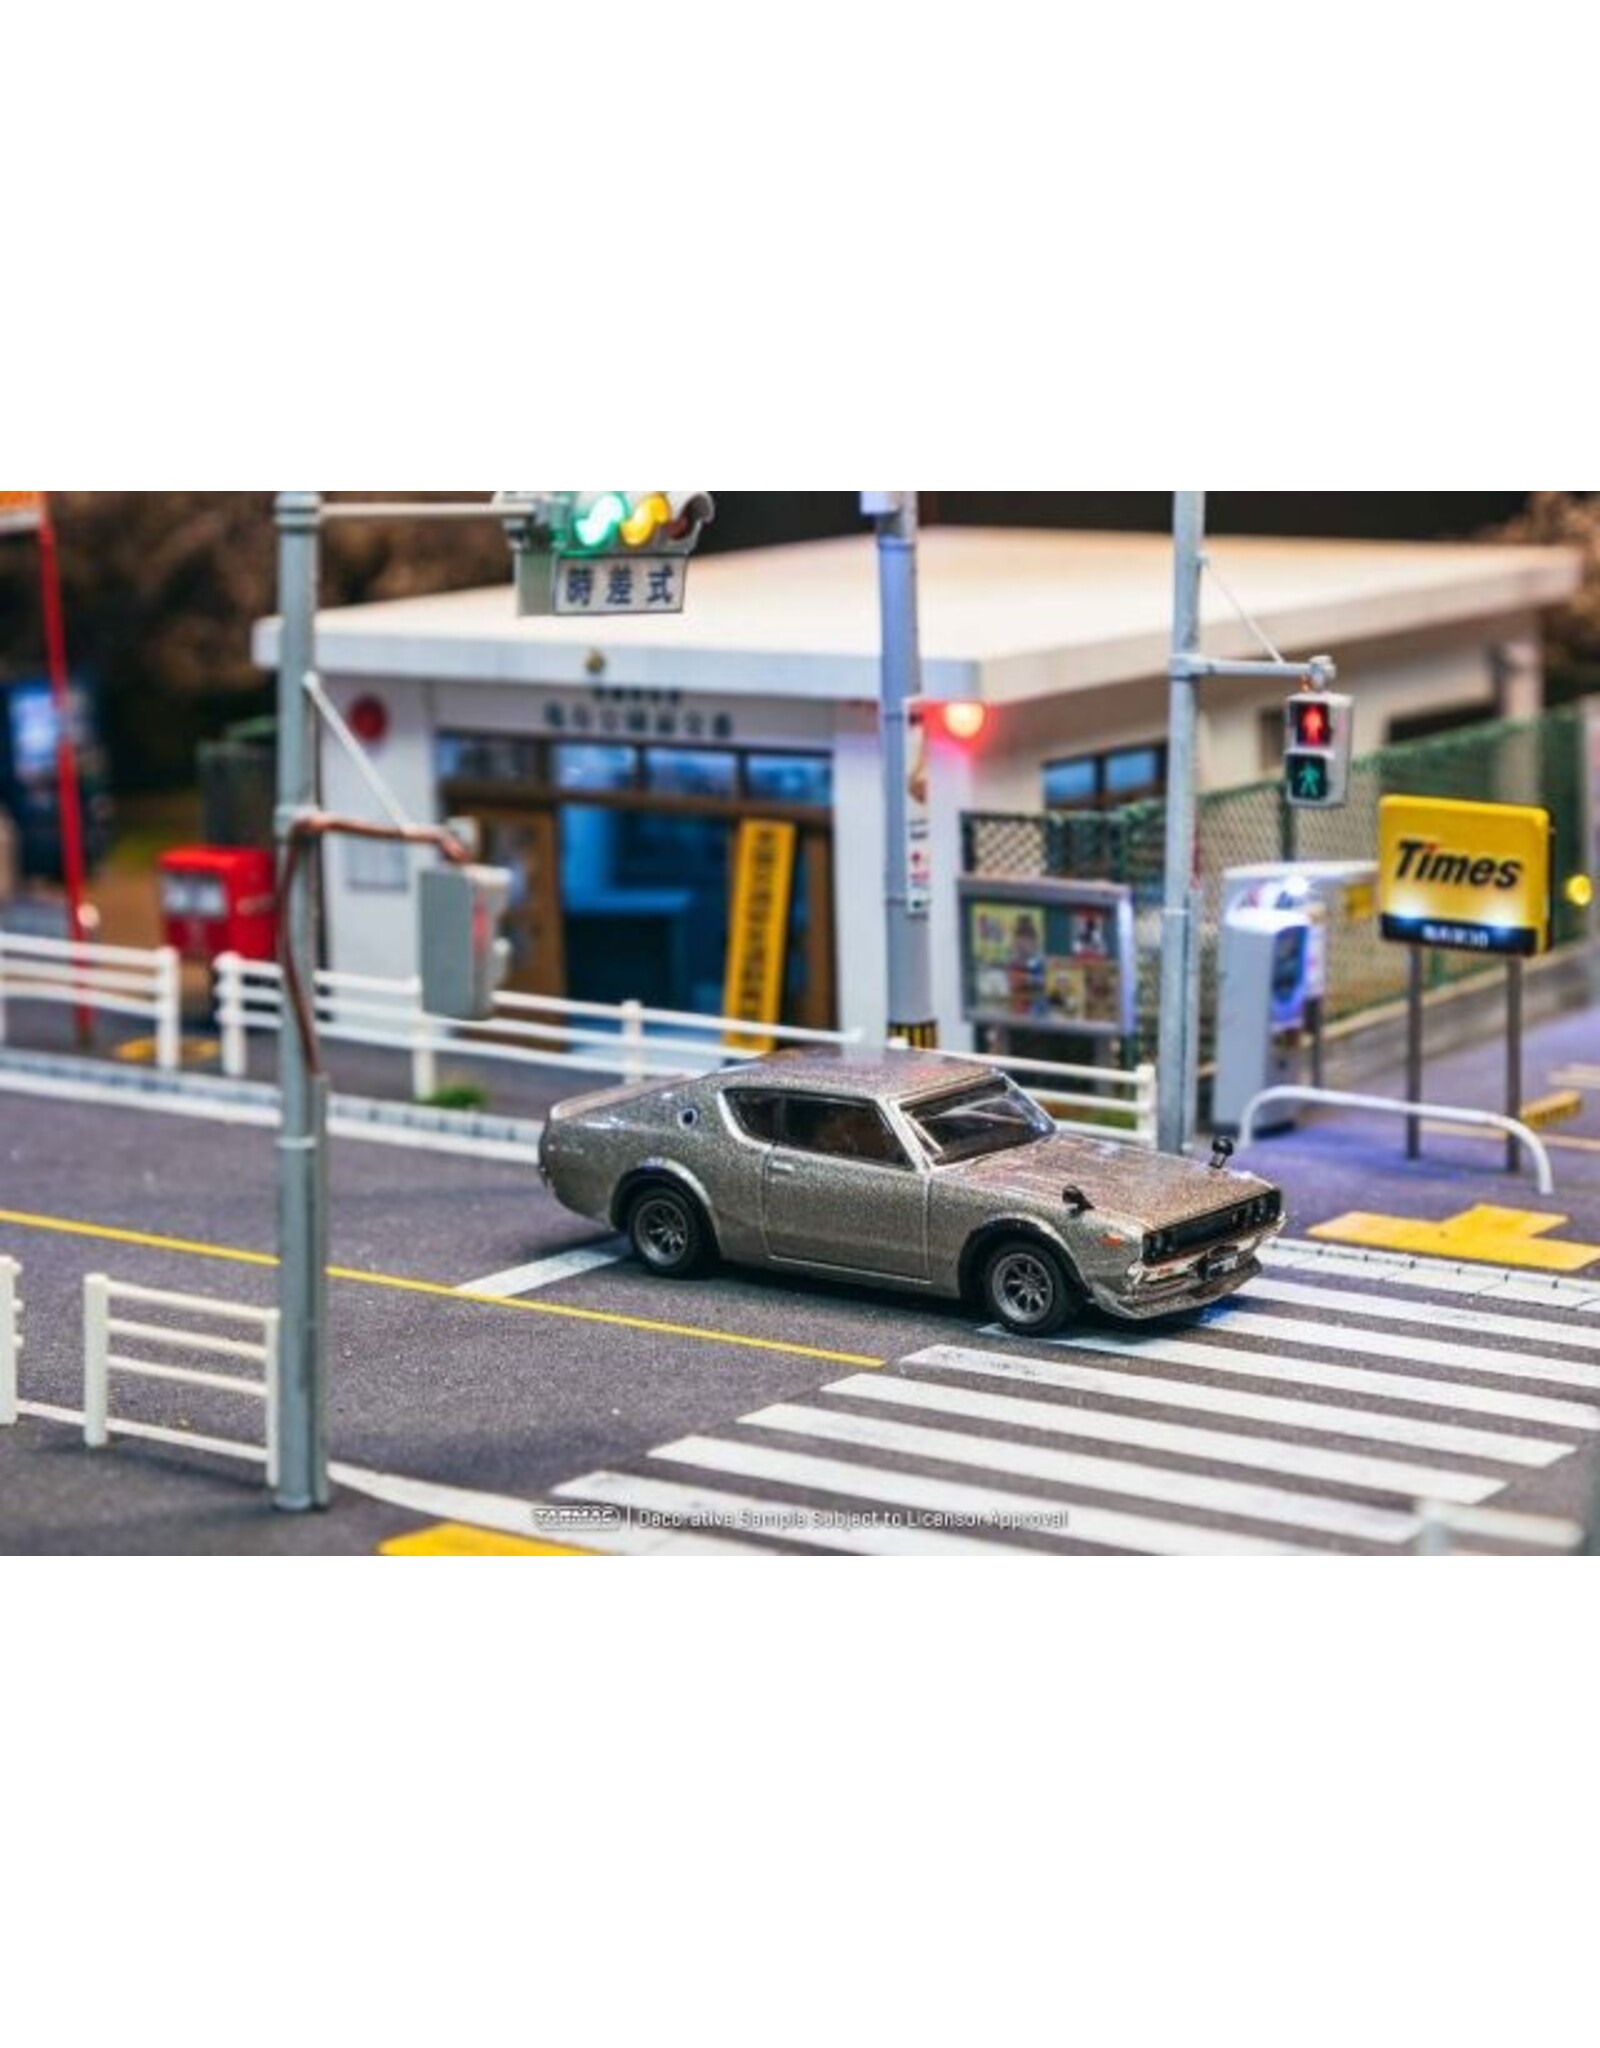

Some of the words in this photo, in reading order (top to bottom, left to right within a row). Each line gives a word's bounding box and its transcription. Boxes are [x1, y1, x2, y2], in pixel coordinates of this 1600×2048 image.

[566, 565, 673, 606] 時差式
[1396, 839, 1523, 888] Times
